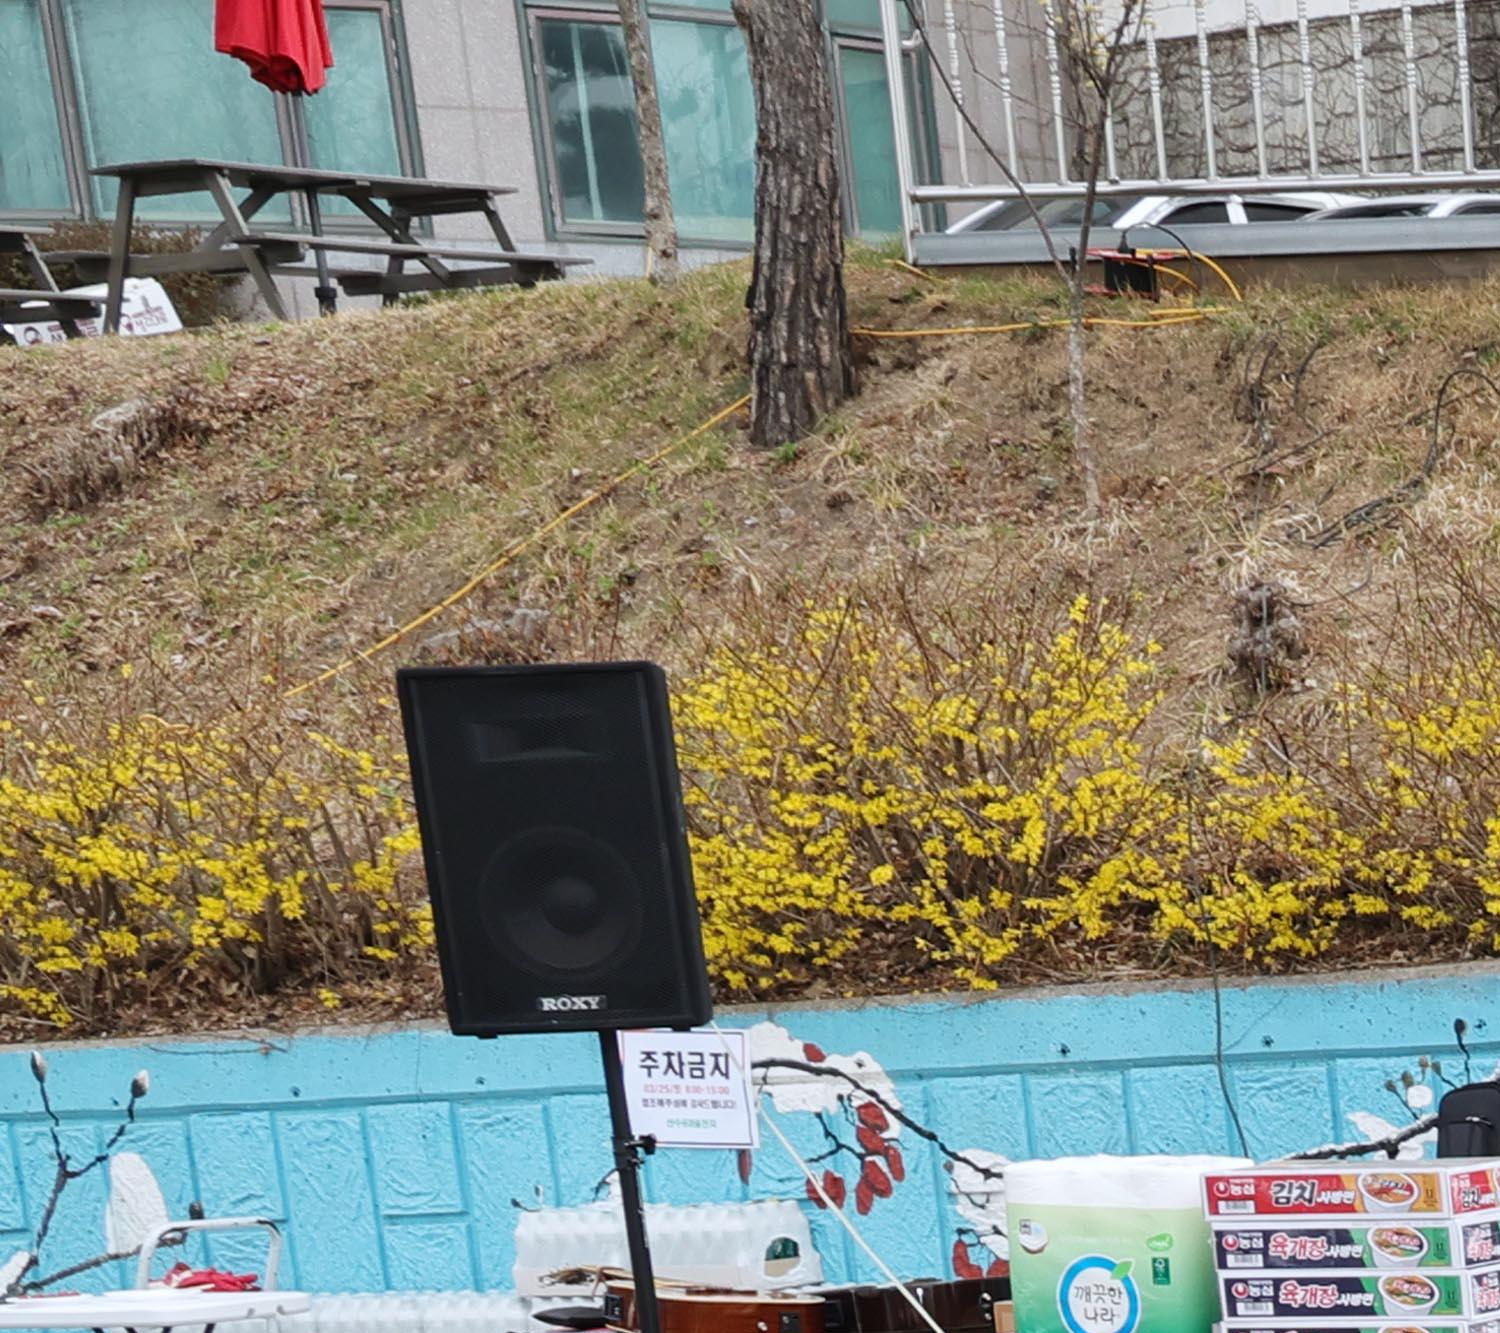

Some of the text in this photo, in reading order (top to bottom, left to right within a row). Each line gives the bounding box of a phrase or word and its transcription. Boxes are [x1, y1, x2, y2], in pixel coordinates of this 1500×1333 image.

[540, 996, 602, 1011] ROXY
[639, 1050, 730, 1080] 주차금지
[1272, 1180, 1317, 1206] 김치
[1269, 1233, 1327, 1260] 육개장
[1074, 1284, 1123, 1305] 깨끗한
[1279, 1280, 1339, 1309] 육개장
[1083, 1307, 1117, 1325] 나라
